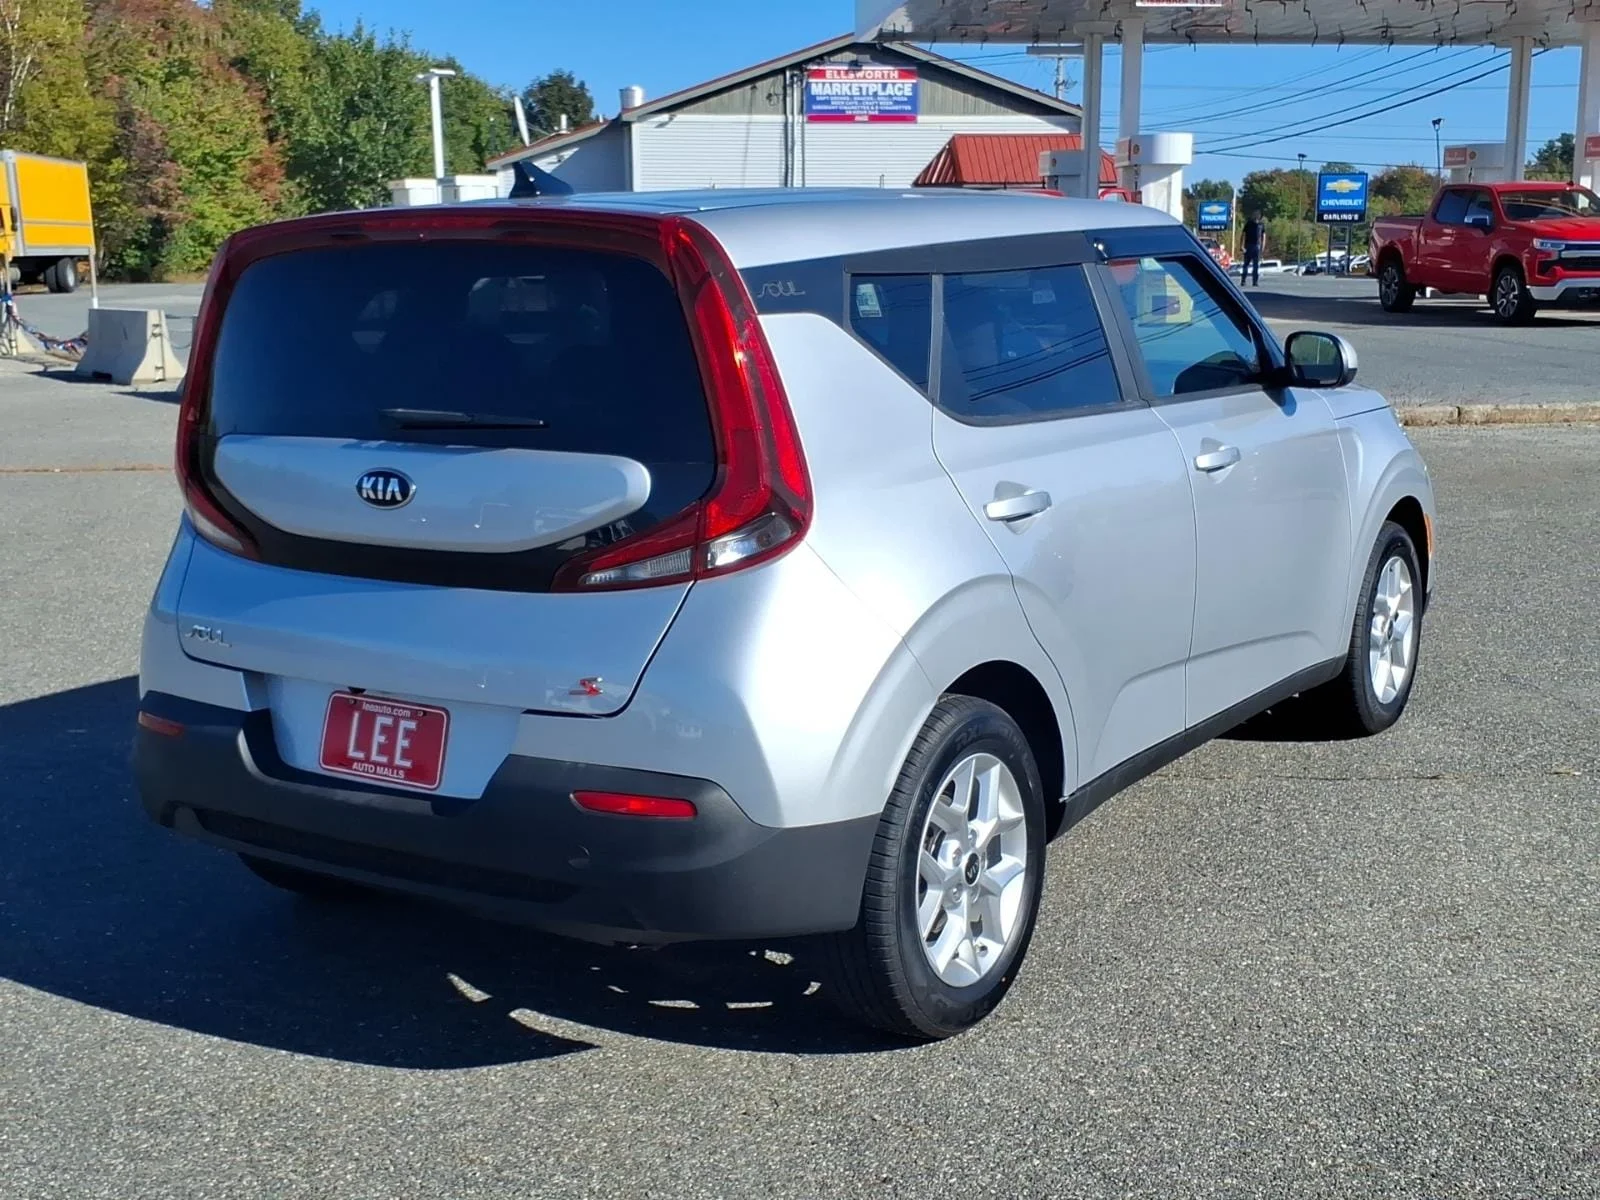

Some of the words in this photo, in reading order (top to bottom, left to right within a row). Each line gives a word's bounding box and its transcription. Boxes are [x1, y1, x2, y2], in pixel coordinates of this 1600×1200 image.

[825, 69, 899, 79] ELLSWORTH
[810, 83, 913, 96] MARKETPLACE
[361, 476, 403, 501] KIA
[362, 701, 411, 718] leeauto.com
[347, 711, 417, 768] LEE
[352, 761, 376, 774] AUTO
[376, 766, 405, 779] MALLS
